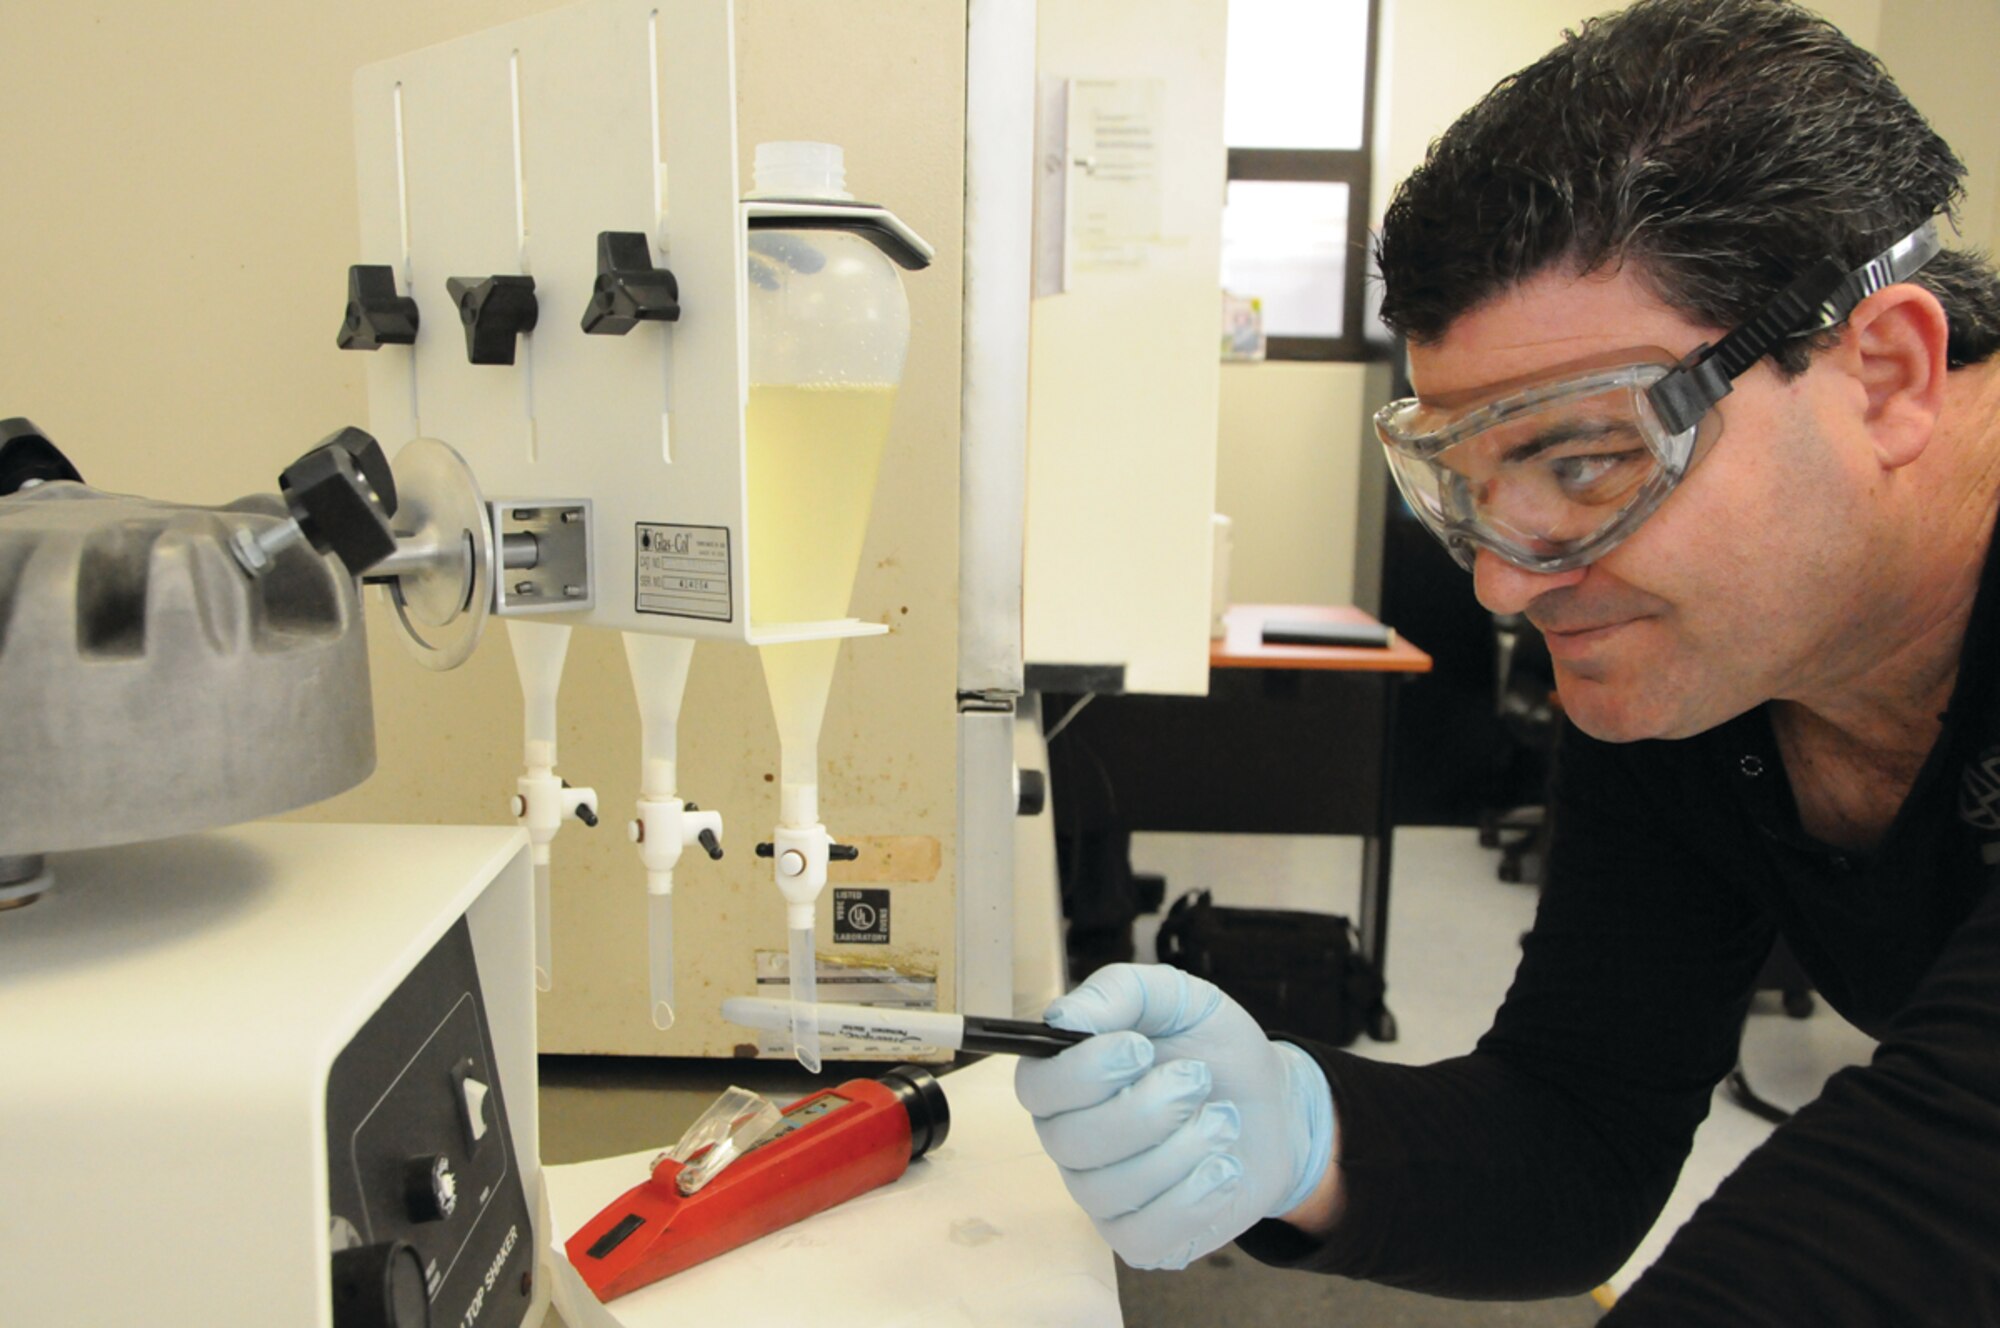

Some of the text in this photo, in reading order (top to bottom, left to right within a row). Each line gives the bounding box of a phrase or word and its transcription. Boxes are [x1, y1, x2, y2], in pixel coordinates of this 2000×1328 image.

[836, 891, 862, 900] LISTED
[835, 933, 888, 942] LABORATORY
[465, 1225, 518, 1328] TOP SHAKER
